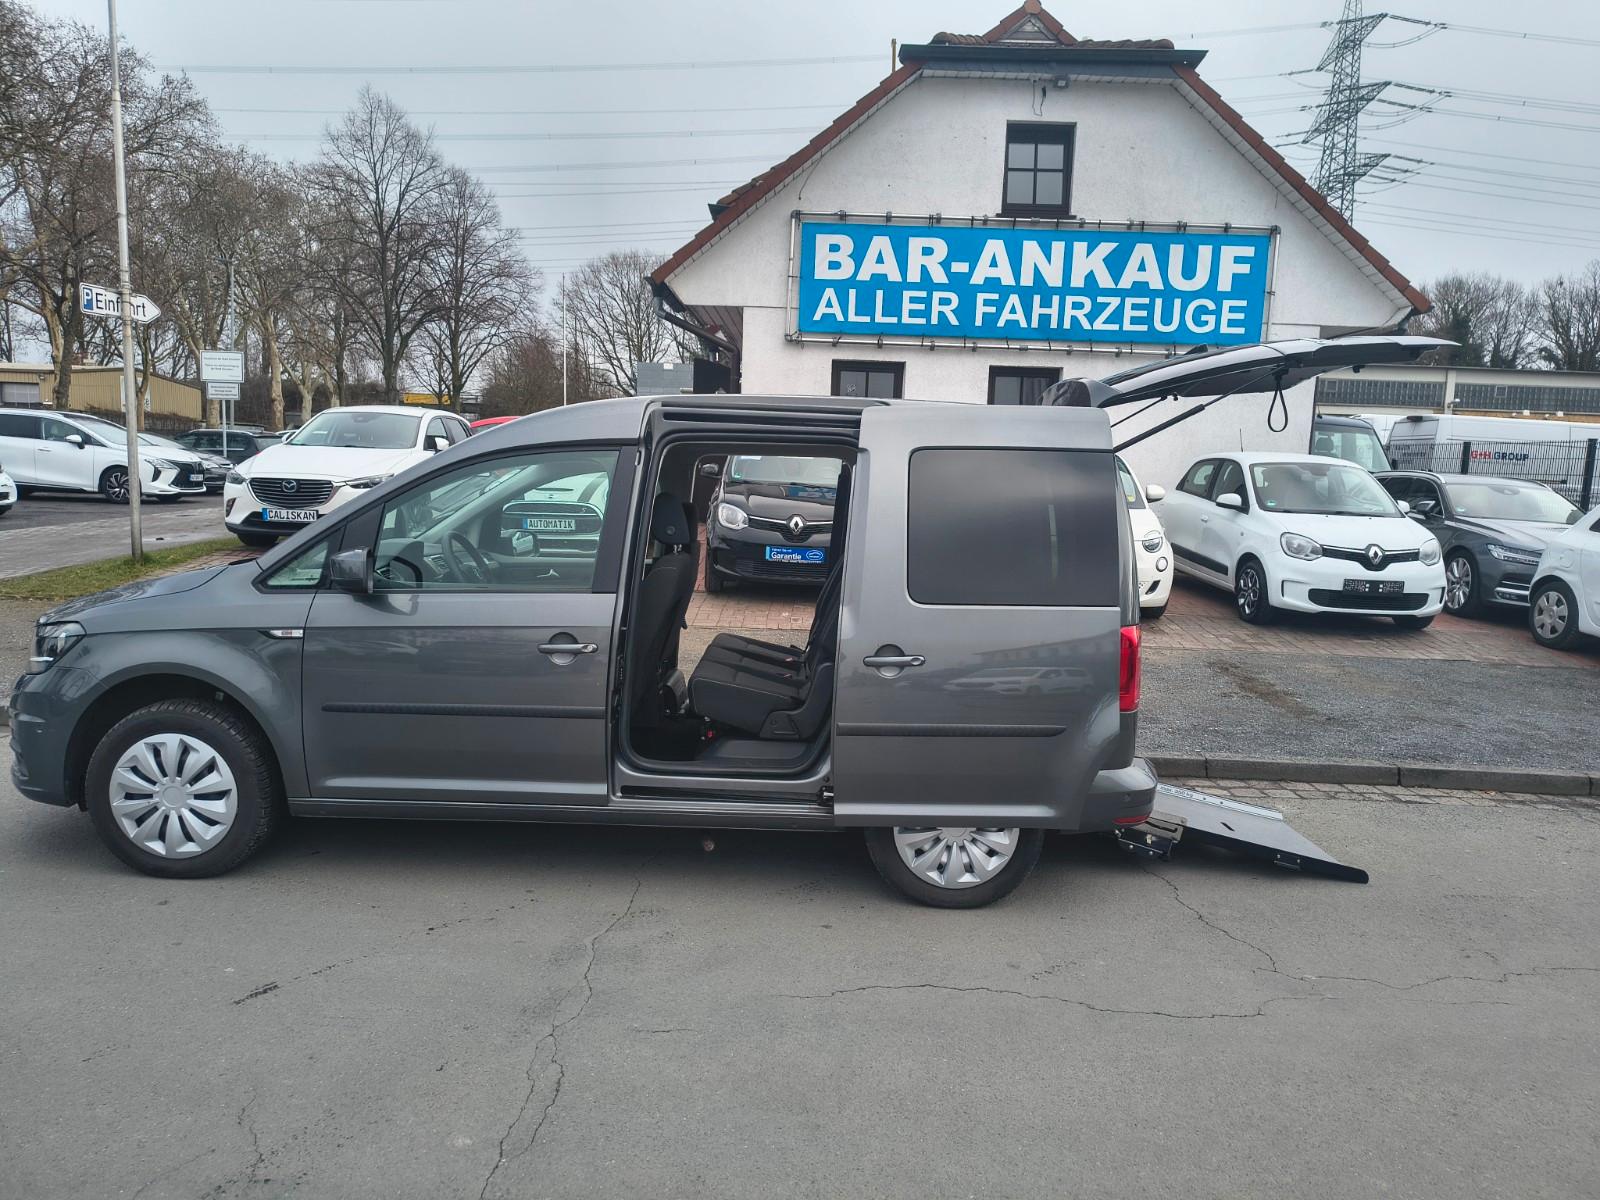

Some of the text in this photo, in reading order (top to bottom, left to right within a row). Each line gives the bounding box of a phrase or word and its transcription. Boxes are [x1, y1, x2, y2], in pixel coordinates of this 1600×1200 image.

[814, 233, 1255, 292] BAR-ANKAUF
[812, 287, 1248, 335] ALLER FAHRZEUGE
[1493, 451, 1529, 461] GROUP
[268, 510, 315, 520] CALISKAN
[528, 519, 573, 529] AUTOMATIK
